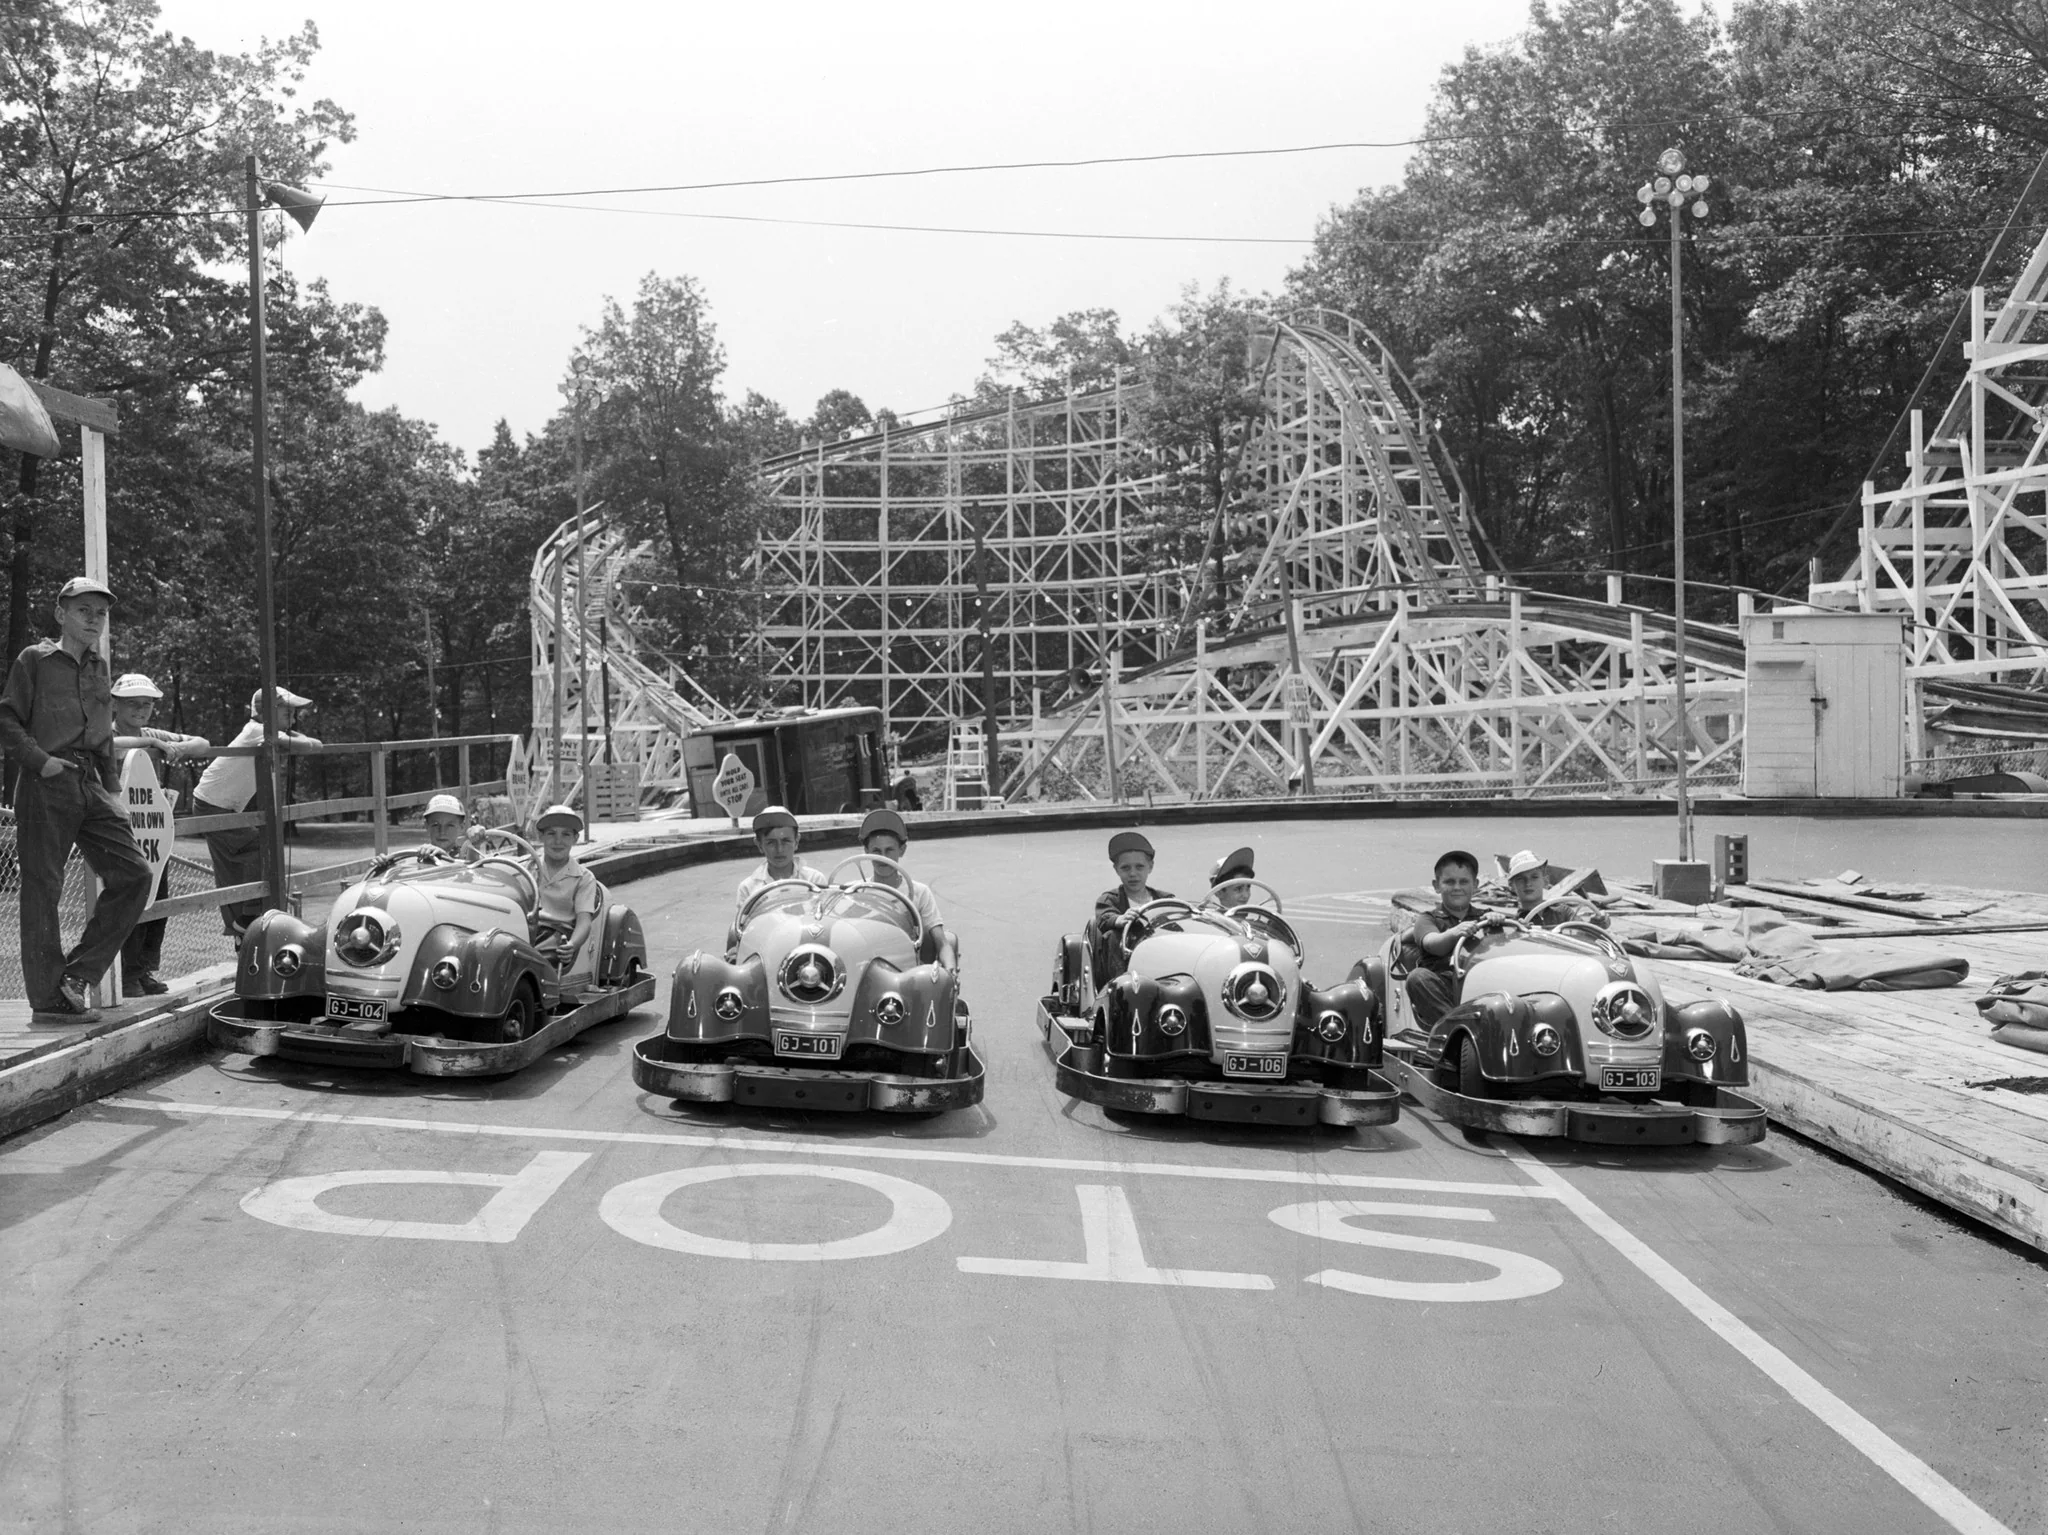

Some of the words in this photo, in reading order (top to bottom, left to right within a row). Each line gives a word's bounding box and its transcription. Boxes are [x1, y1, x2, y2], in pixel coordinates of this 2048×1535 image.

[128, 787, 153, 805] RIDE
[727, 794, 743, 805] STOP
[146, 811, 165, 829] OWN
[331, 1000, 383, 1018] GJ-104
[781, 1036, 836, 1053] GJ-101
[1229, 1057, 1281, 1072] GJ-106
[1606, 1072, 1656, 1086] GJ-103
[239, 1151, 1564, 1303] STOP
